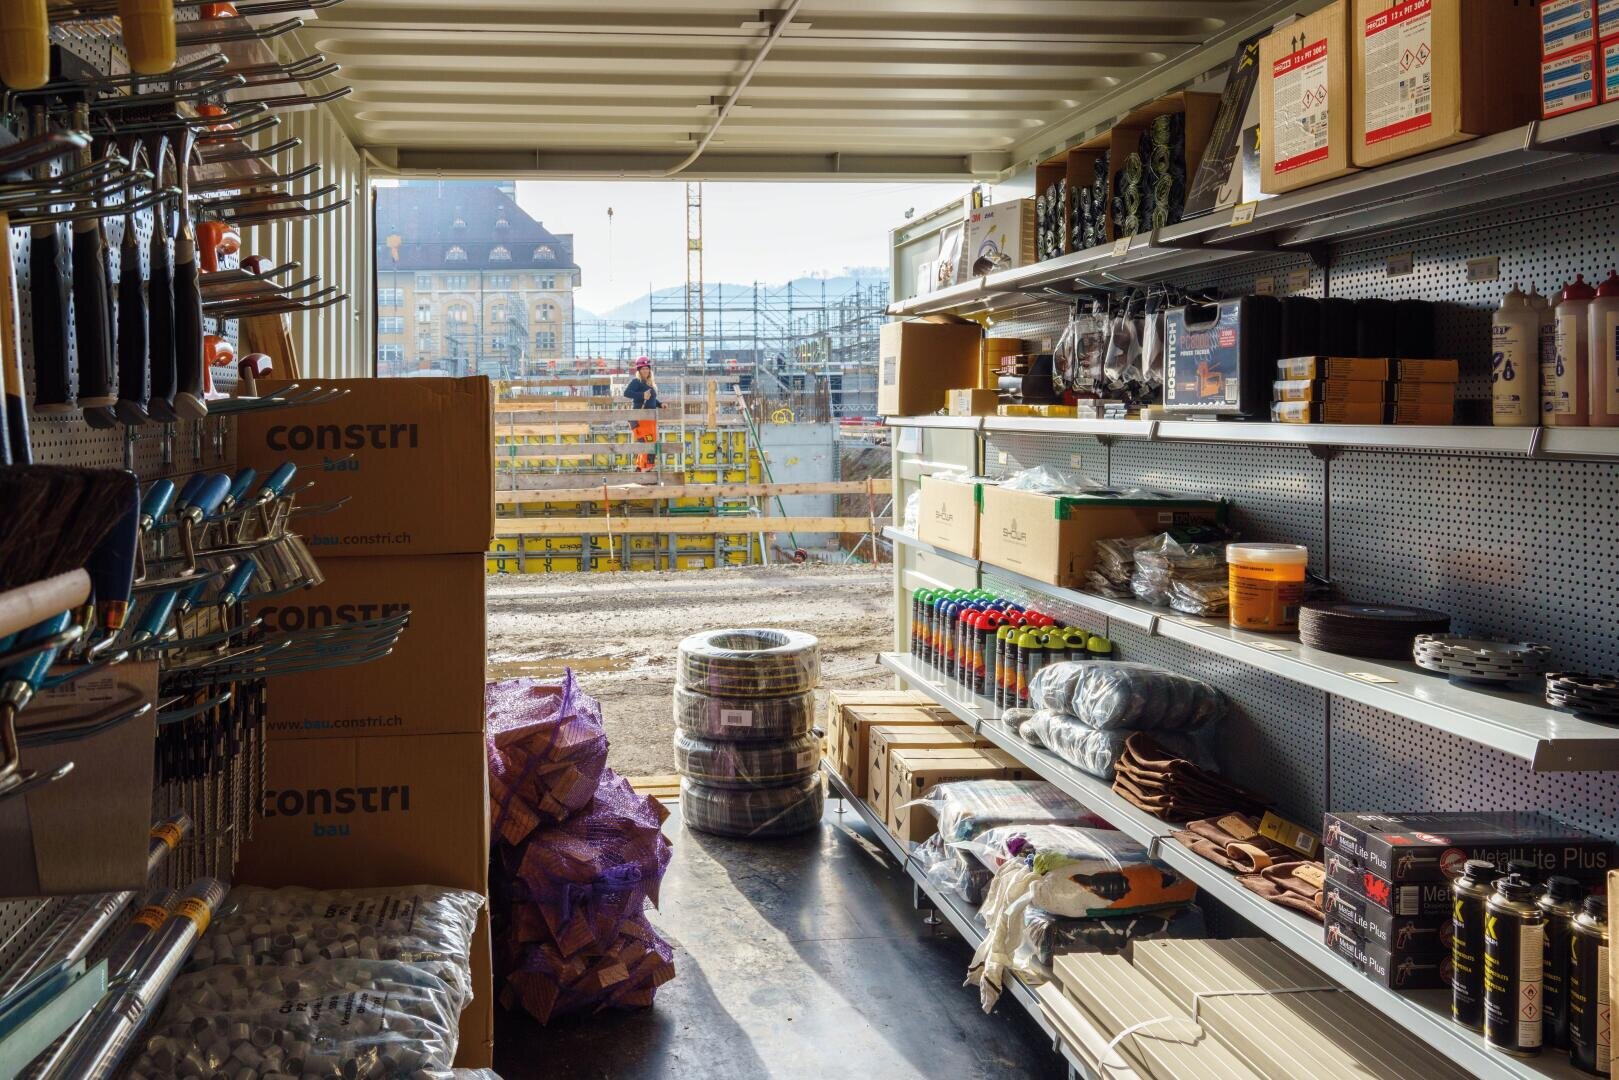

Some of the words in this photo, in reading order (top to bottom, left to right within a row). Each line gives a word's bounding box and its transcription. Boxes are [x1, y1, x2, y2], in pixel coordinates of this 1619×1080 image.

[971, 213, 981, 223] 3M
[1167, 322, 1177, 400] BOSTITCH
[266, 423, 419, 451] constri
[323, 456, 360, 472] bau
[302, 532, 411, 546] .bau.constri.ch
[256, 784, 410, 817] constri
[313, 821, 350, 837] bau
[1354, 843, 1368, 860] Lite
[1370, 851, 1387, 869] Plus
[1564, 847, 1607, 869] Plus
[1424, 885, 1451, 902] Met
[1354, 912, 1368, 929] Lite
[1369, 921, 1387, 941] Plus
[1355, 946, 1368, 965] Lite
[1368, 954, 1386, 977] Plus
